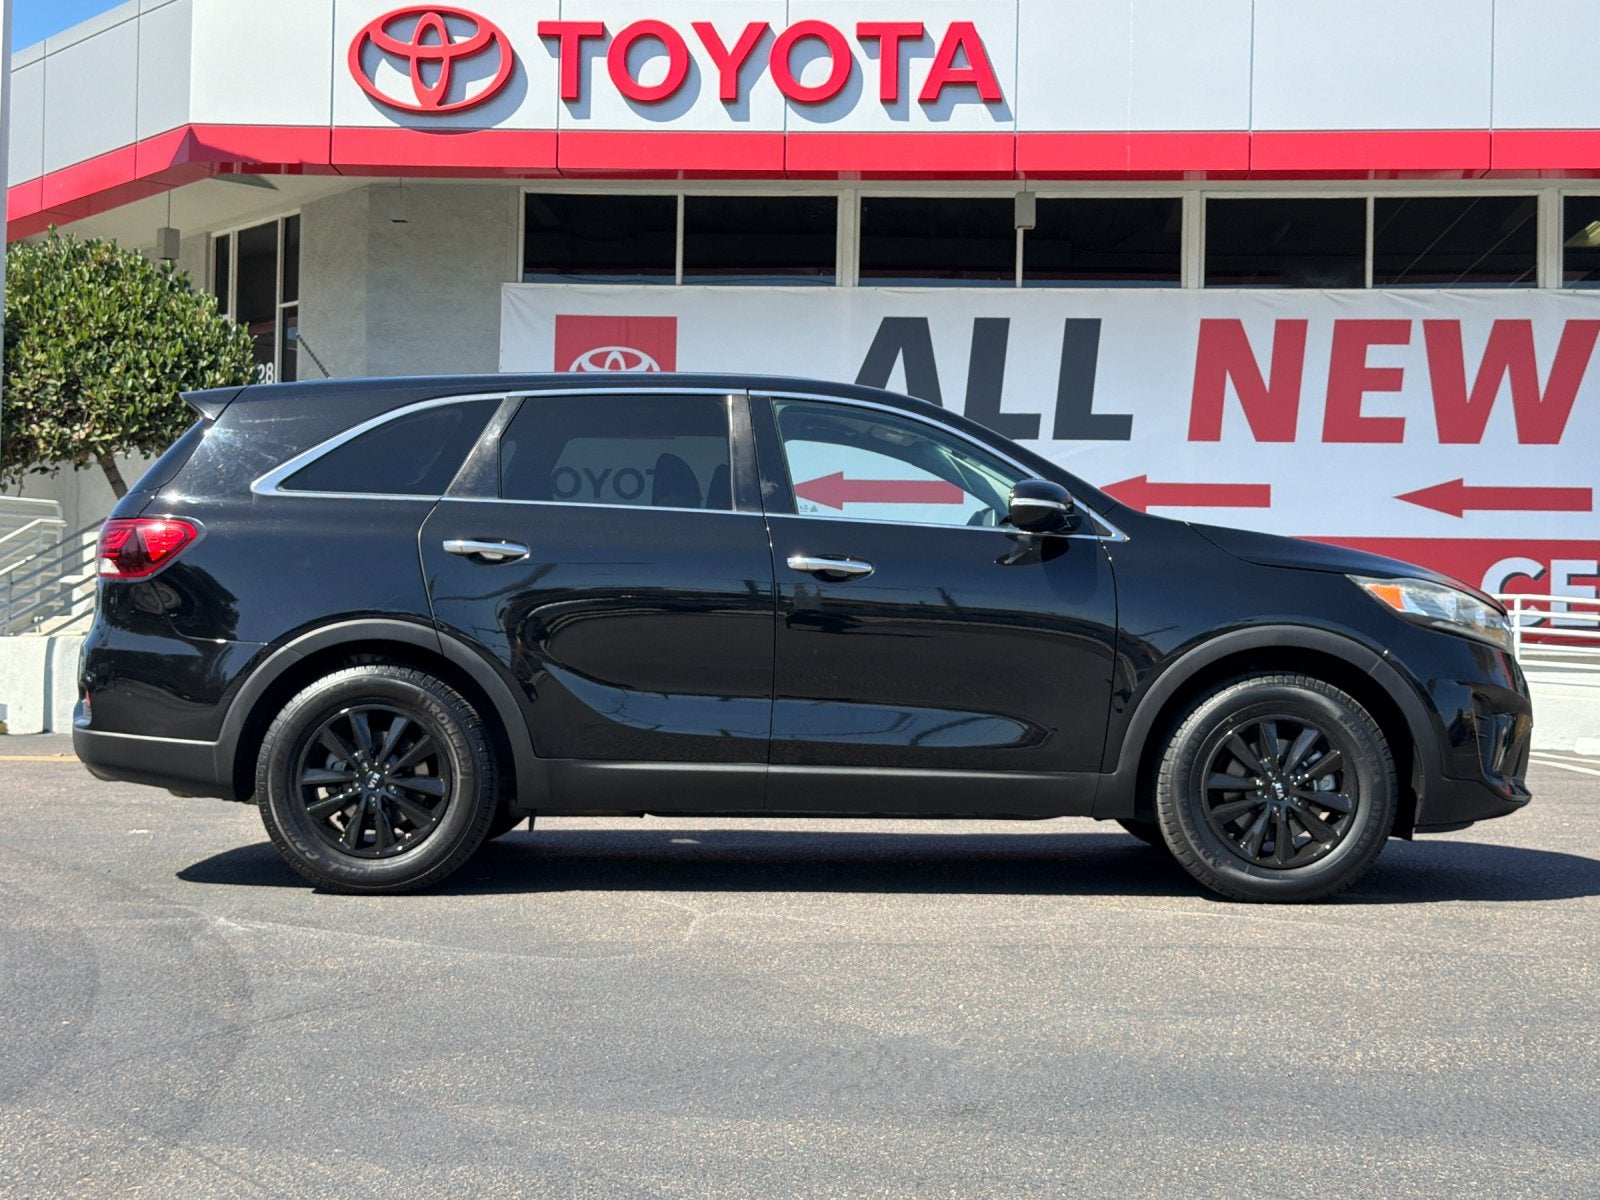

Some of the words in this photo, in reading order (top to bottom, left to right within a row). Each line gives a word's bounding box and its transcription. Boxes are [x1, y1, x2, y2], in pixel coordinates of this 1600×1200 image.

[537, 19, 1003, 104] TOYOTA
[853, 316, 1133, 440] ALL
[1187, 318, 1600, 445] NEW
